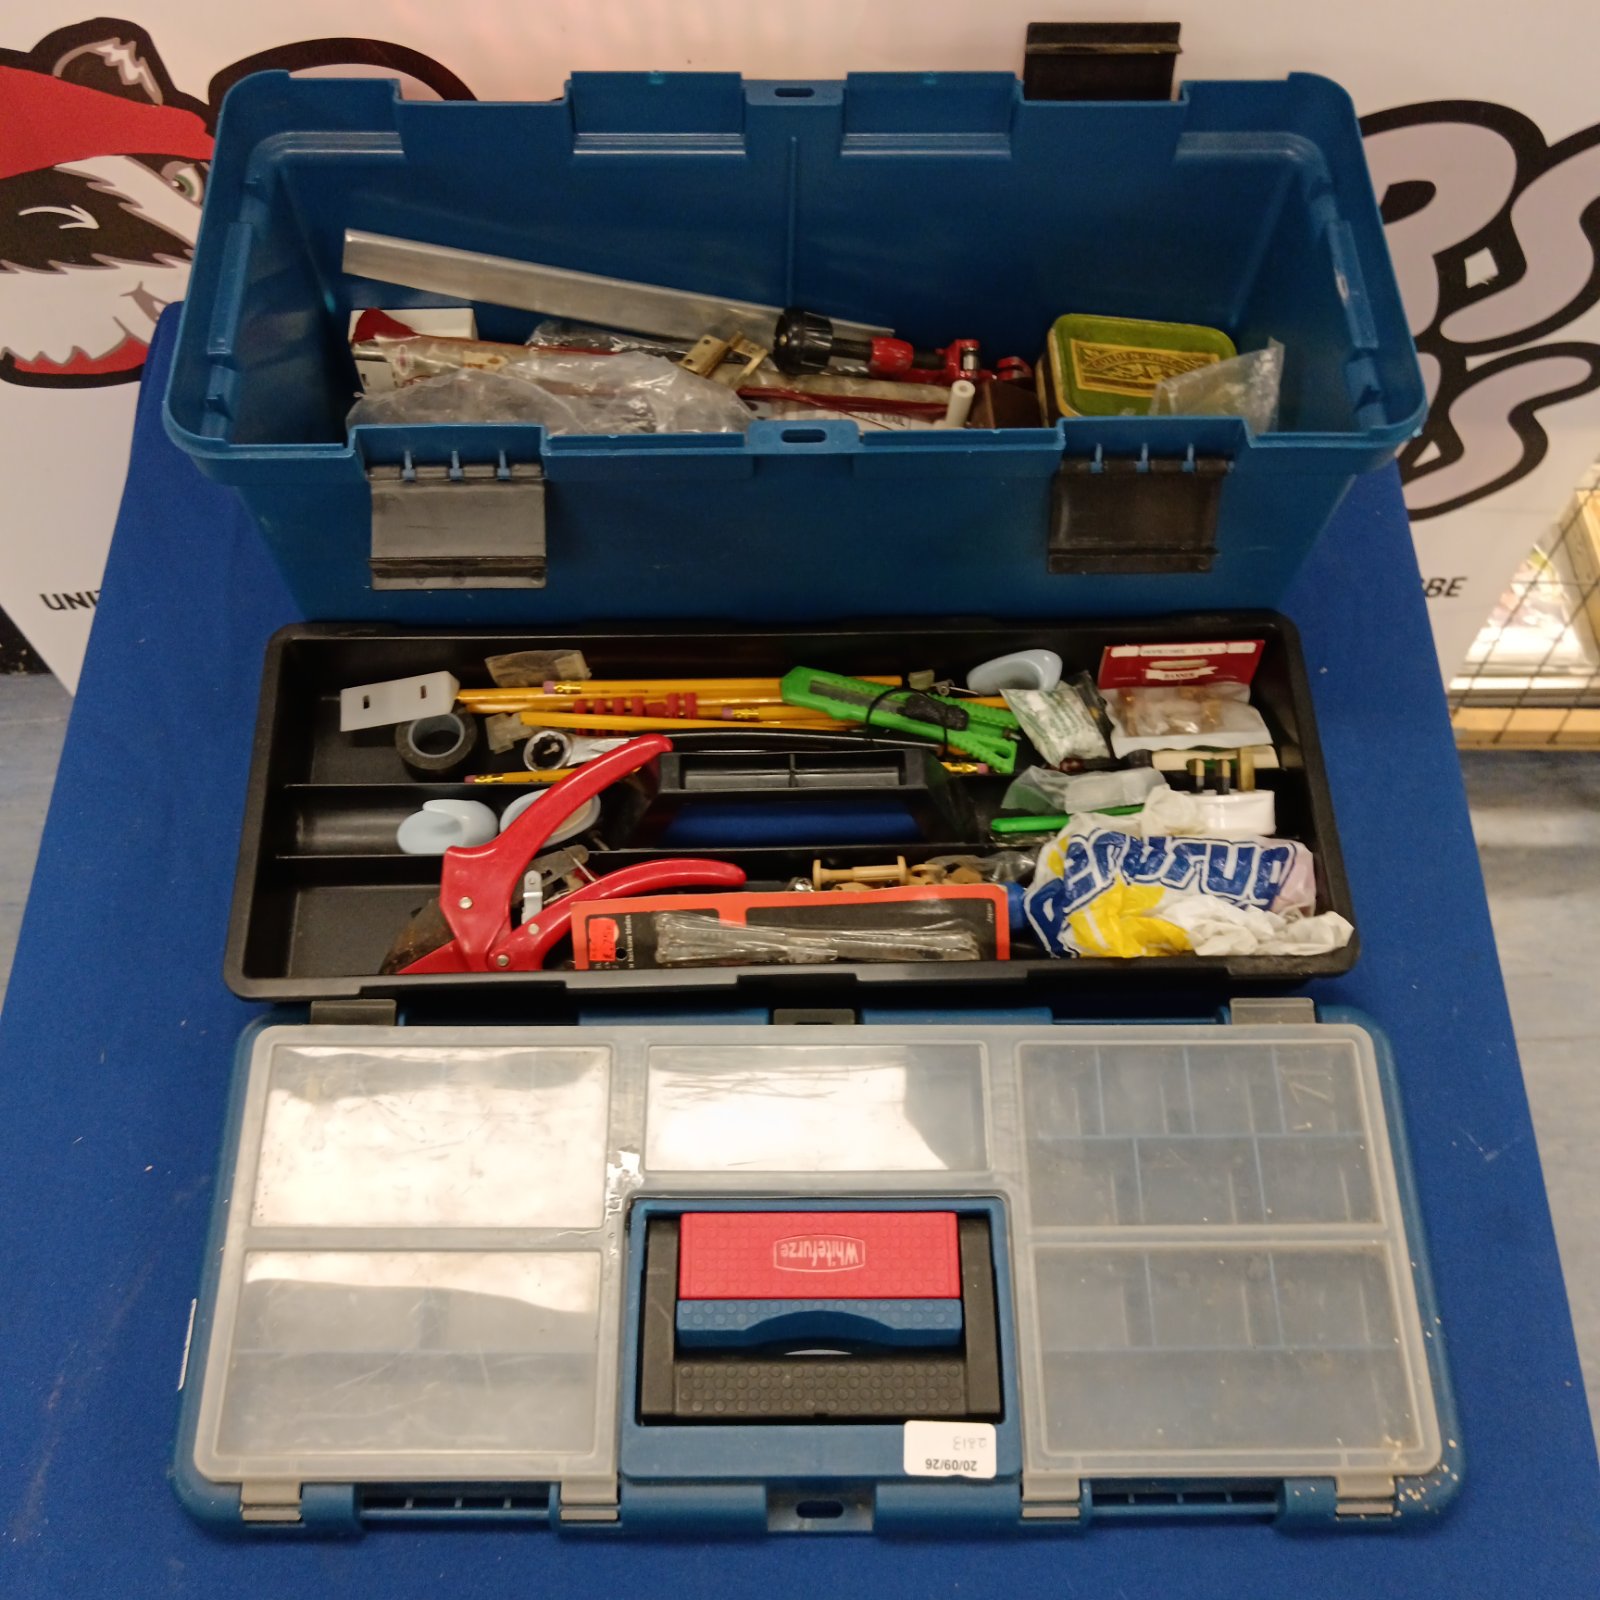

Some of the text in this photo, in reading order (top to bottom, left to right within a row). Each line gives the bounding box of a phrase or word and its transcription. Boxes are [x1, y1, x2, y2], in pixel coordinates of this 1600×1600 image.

[40, 590, 100, 610] UNI
[780, 1240, 859, 1267] Whitefurze
[924, 1458, 978, 1472] 20/09/26
